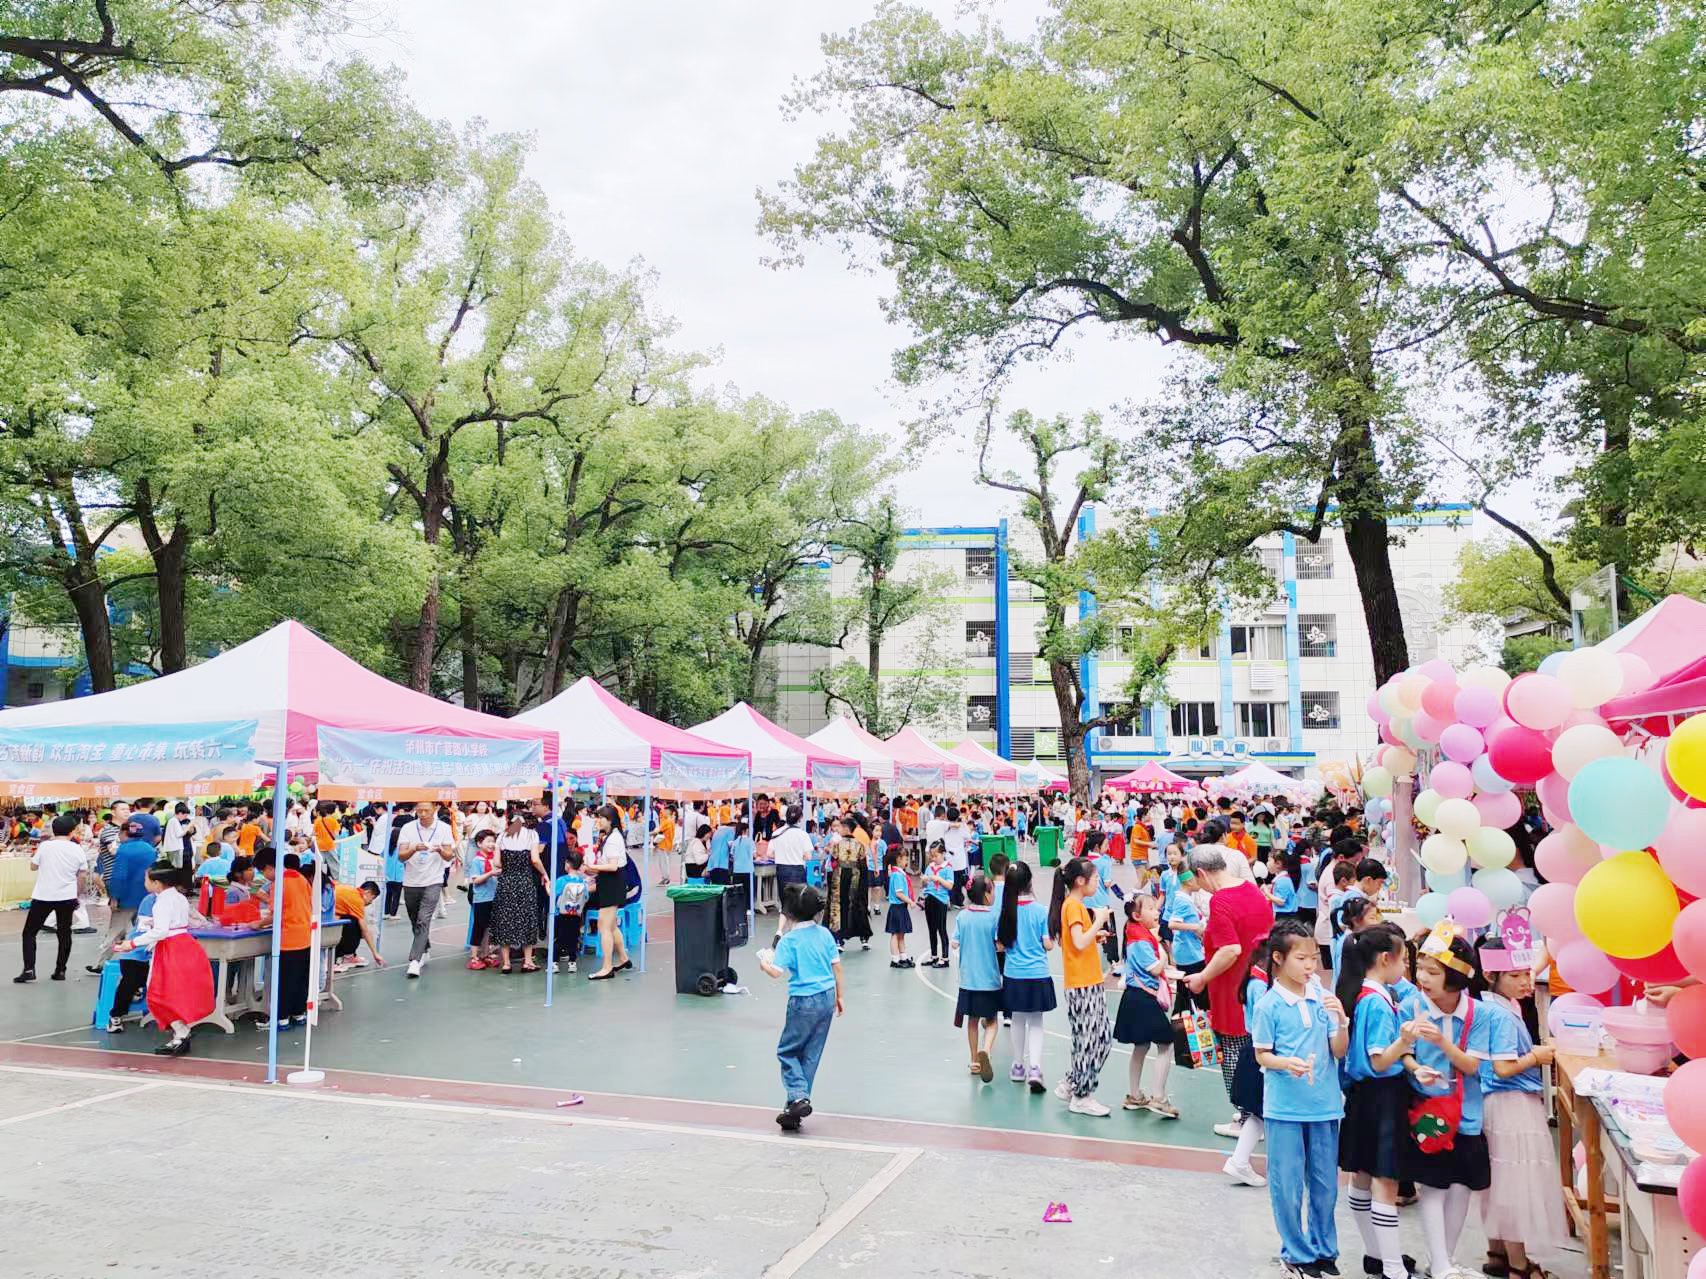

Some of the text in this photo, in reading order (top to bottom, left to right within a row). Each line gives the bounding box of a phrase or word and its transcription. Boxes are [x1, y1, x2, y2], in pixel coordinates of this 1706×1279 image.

[50, 743, 106, 761] 欢乐淘宝
[109, 742, 168, 761] 童心市集
[174, 737, 238, 760] 玩转六一
